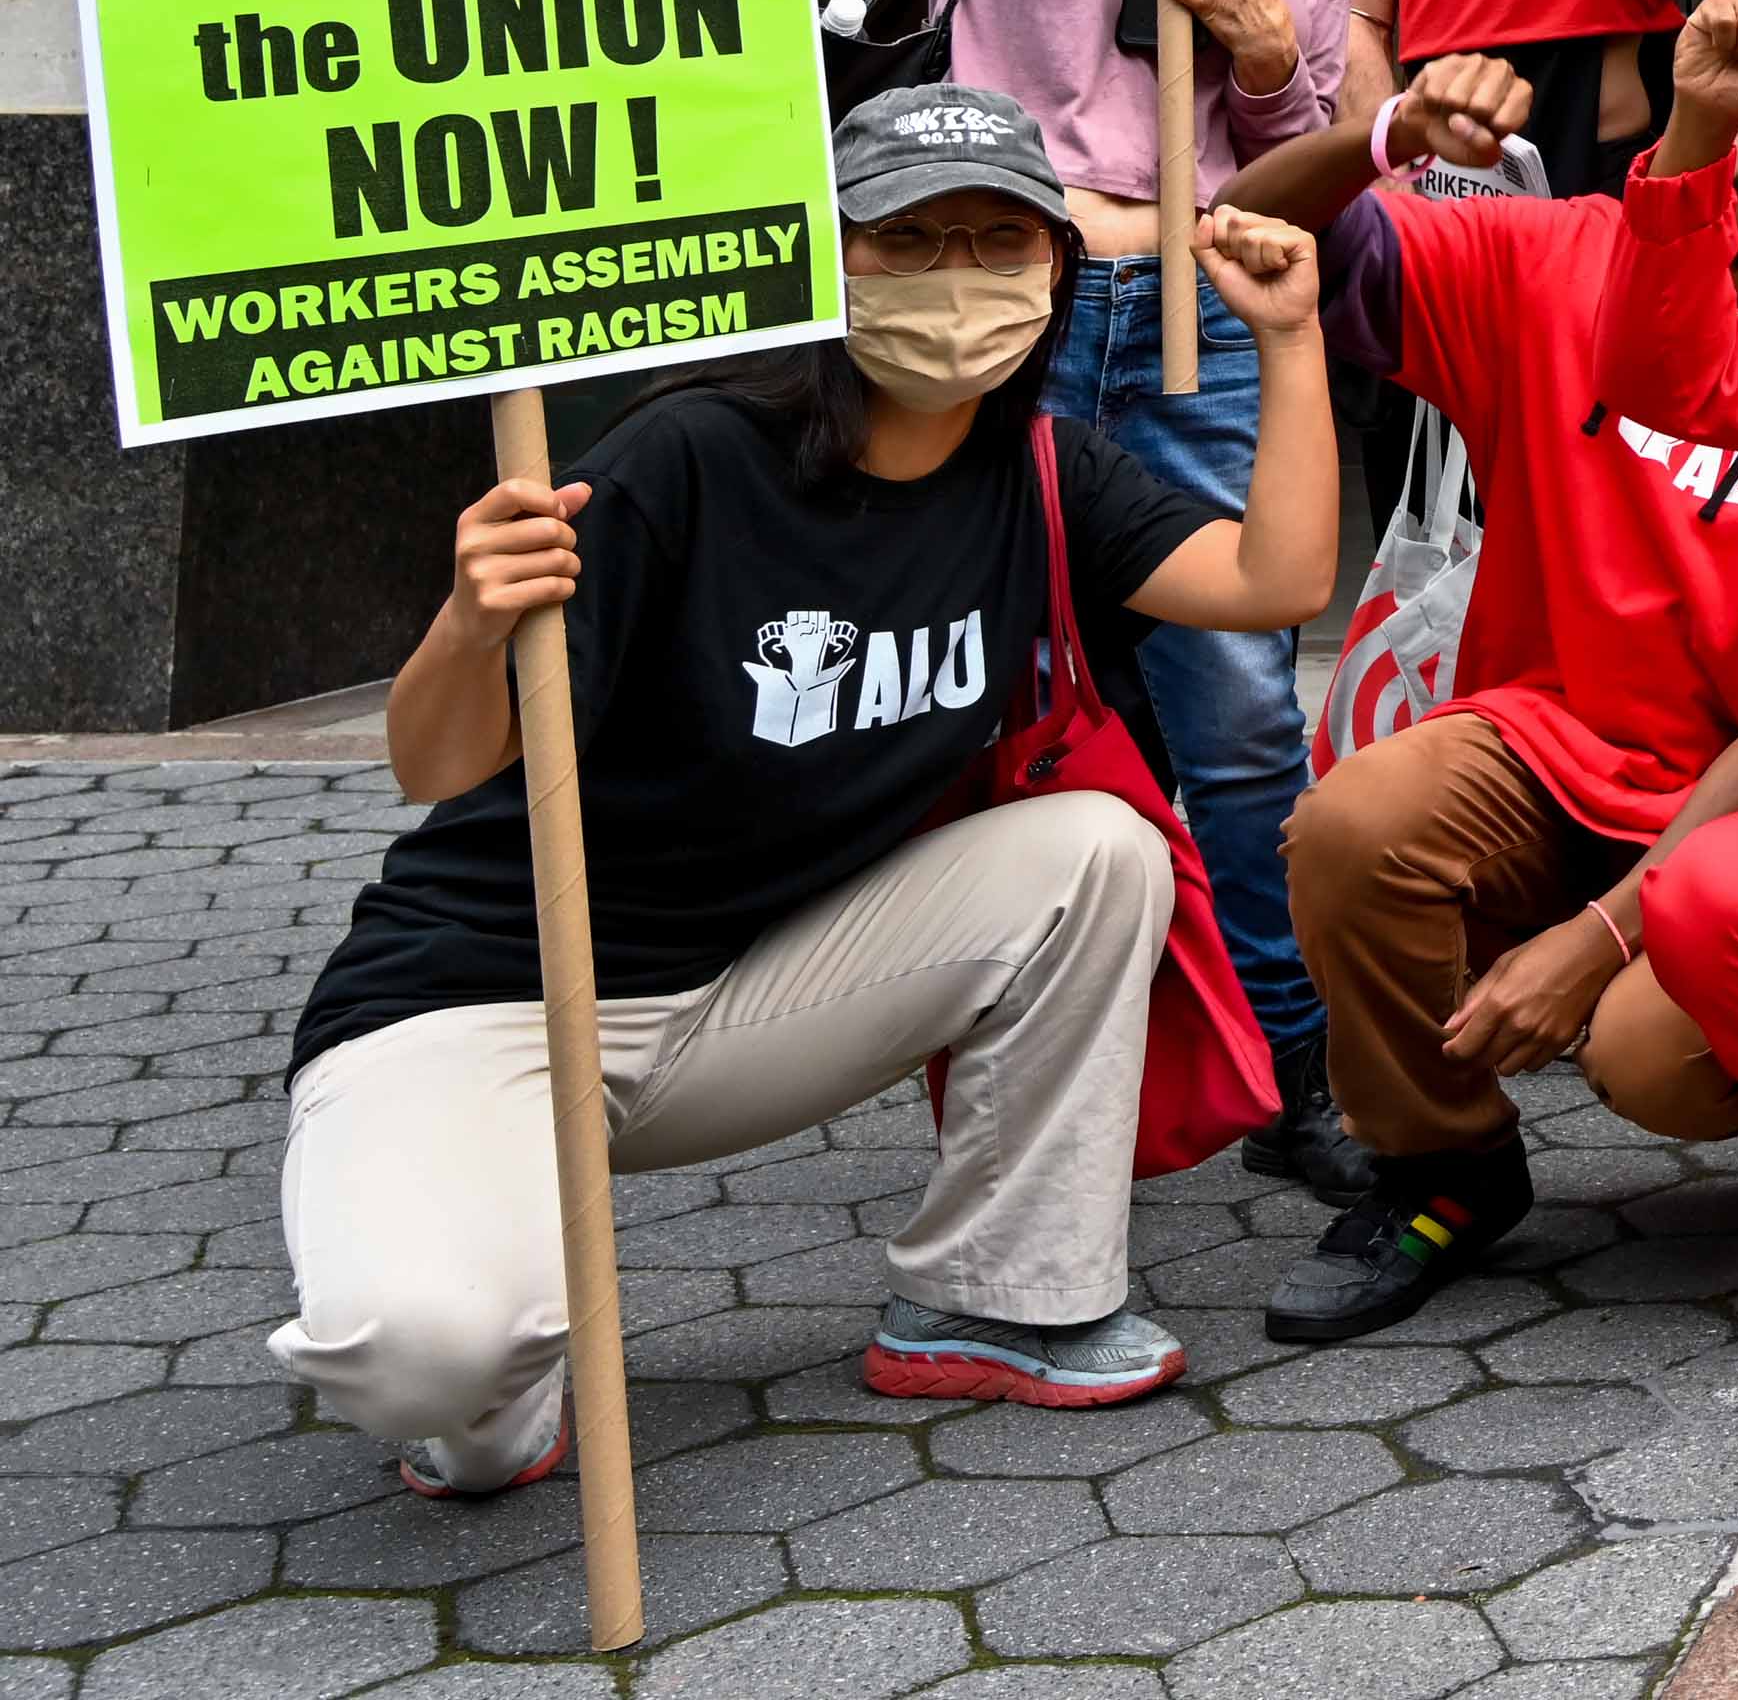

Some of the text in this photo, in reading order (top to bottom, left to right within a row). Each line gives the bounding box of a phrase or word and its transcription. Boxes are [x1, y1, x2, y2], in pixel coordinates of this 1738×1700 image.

[194, 11, 361, 103] the
[326, 100, 598, 240] NOW
[918, 131, 999, 146] 90.3 FM
[162, 222, 802, 345] WORKERS ASSEMBLY
[244, 291, 748, 404] AGAINST RACISM
[854, 609, 987, 731] ALU
